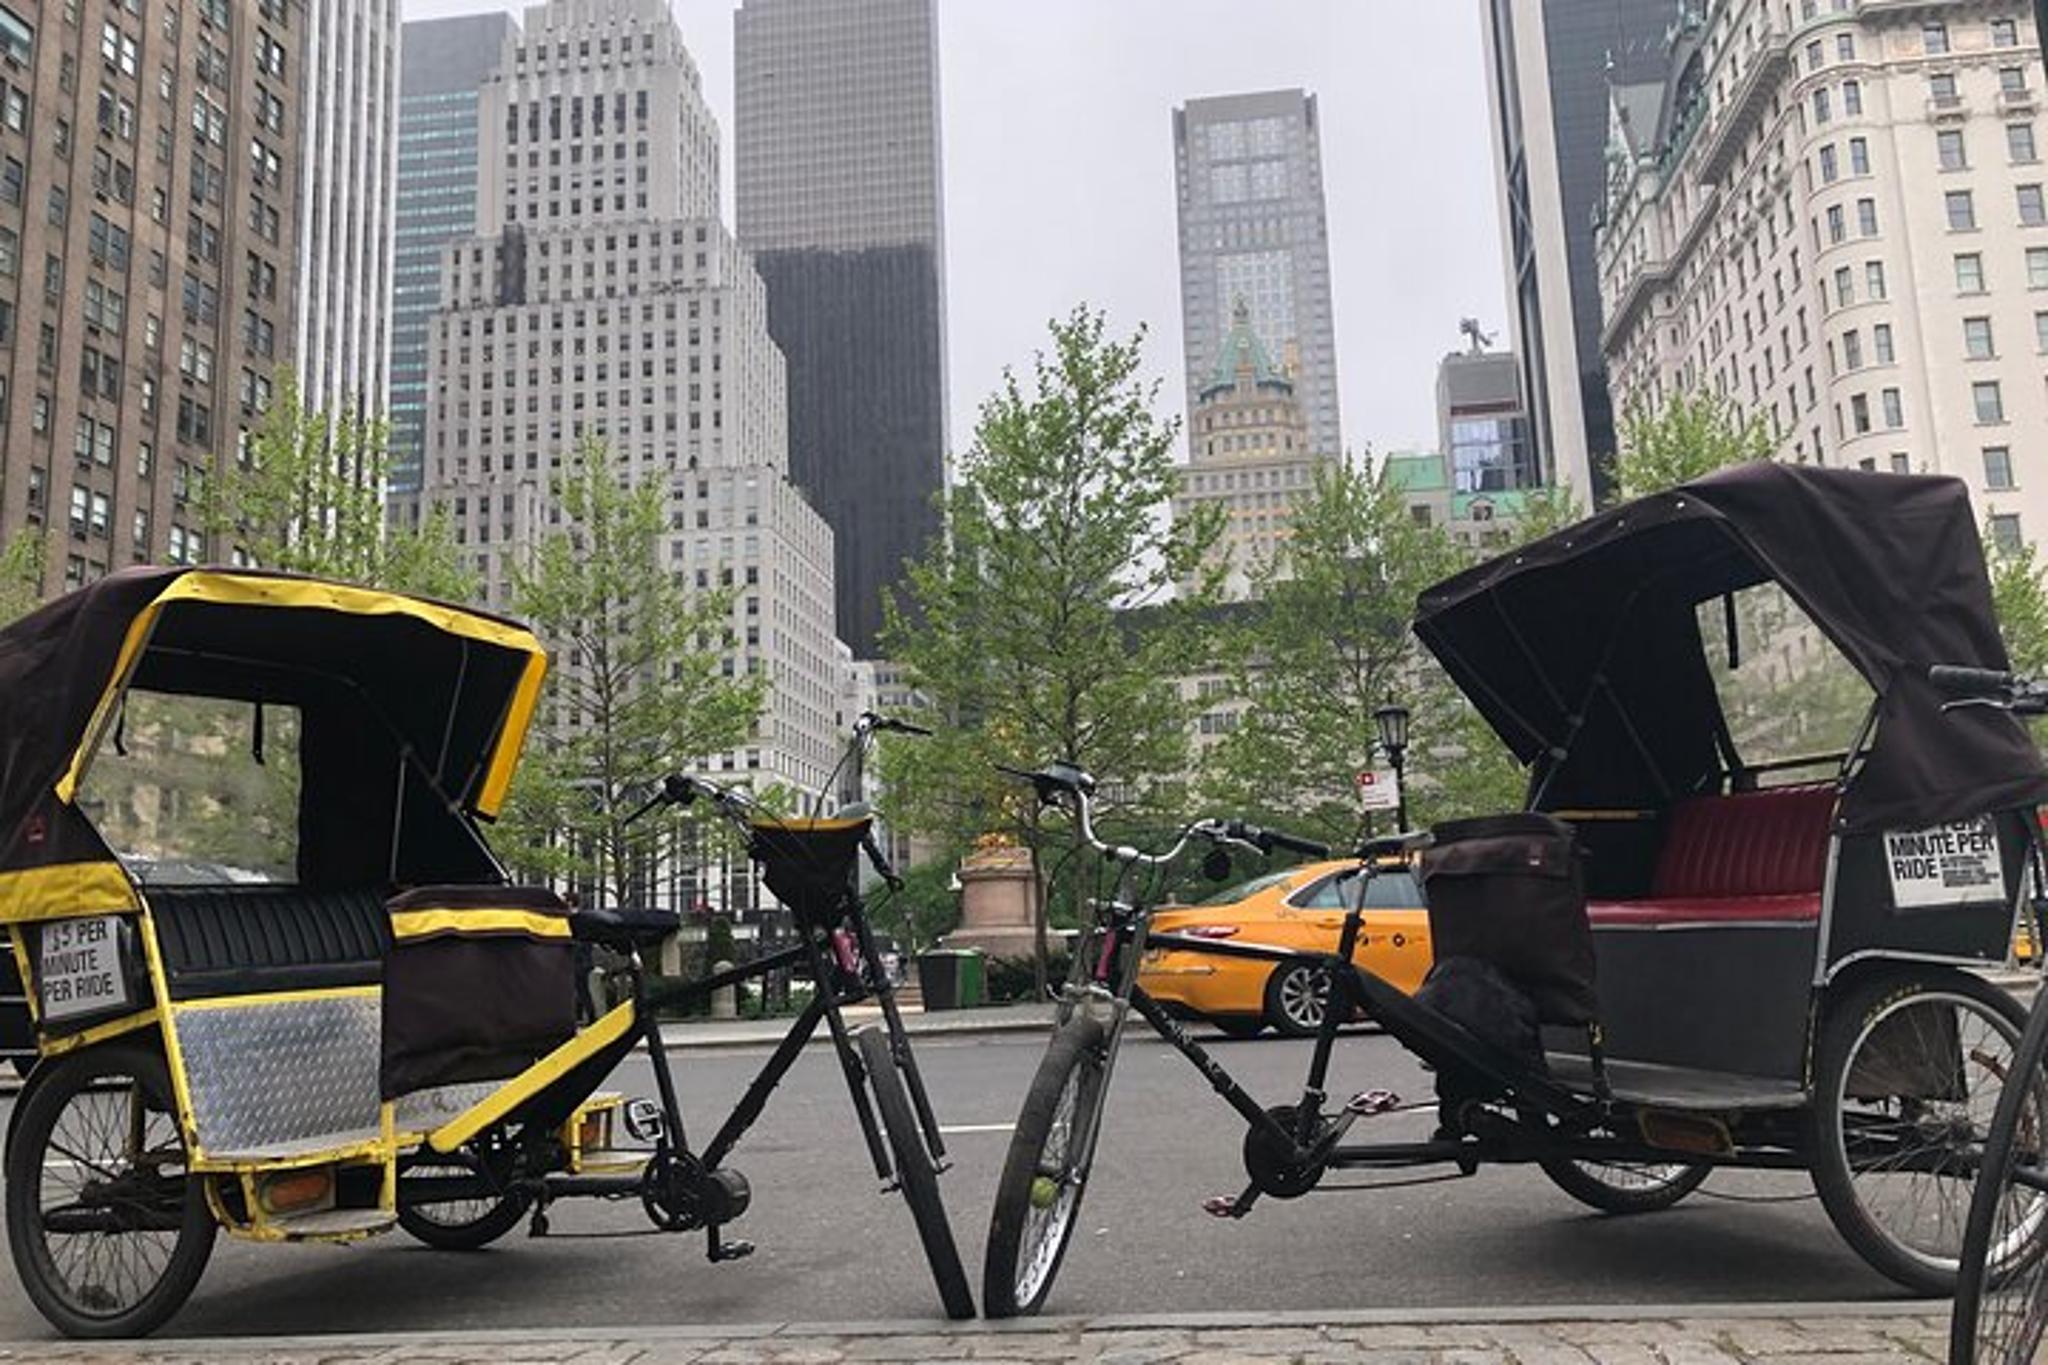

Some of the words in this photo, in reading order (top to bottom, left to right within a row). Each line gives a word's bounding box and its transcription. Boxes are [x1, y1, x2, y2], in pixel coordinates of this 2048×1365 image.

[1889, 834, 1955, 857] MINUTE
[1957, 832, 1996, 854] PER
[1894, 857, 1938, 881] RIDE
[77, 920, 108, 943] PER
[43, 949, 98, 975] MINUTE
[44, 978, 72, 1001] PER
[75, 973, 114, 998] RIDE
